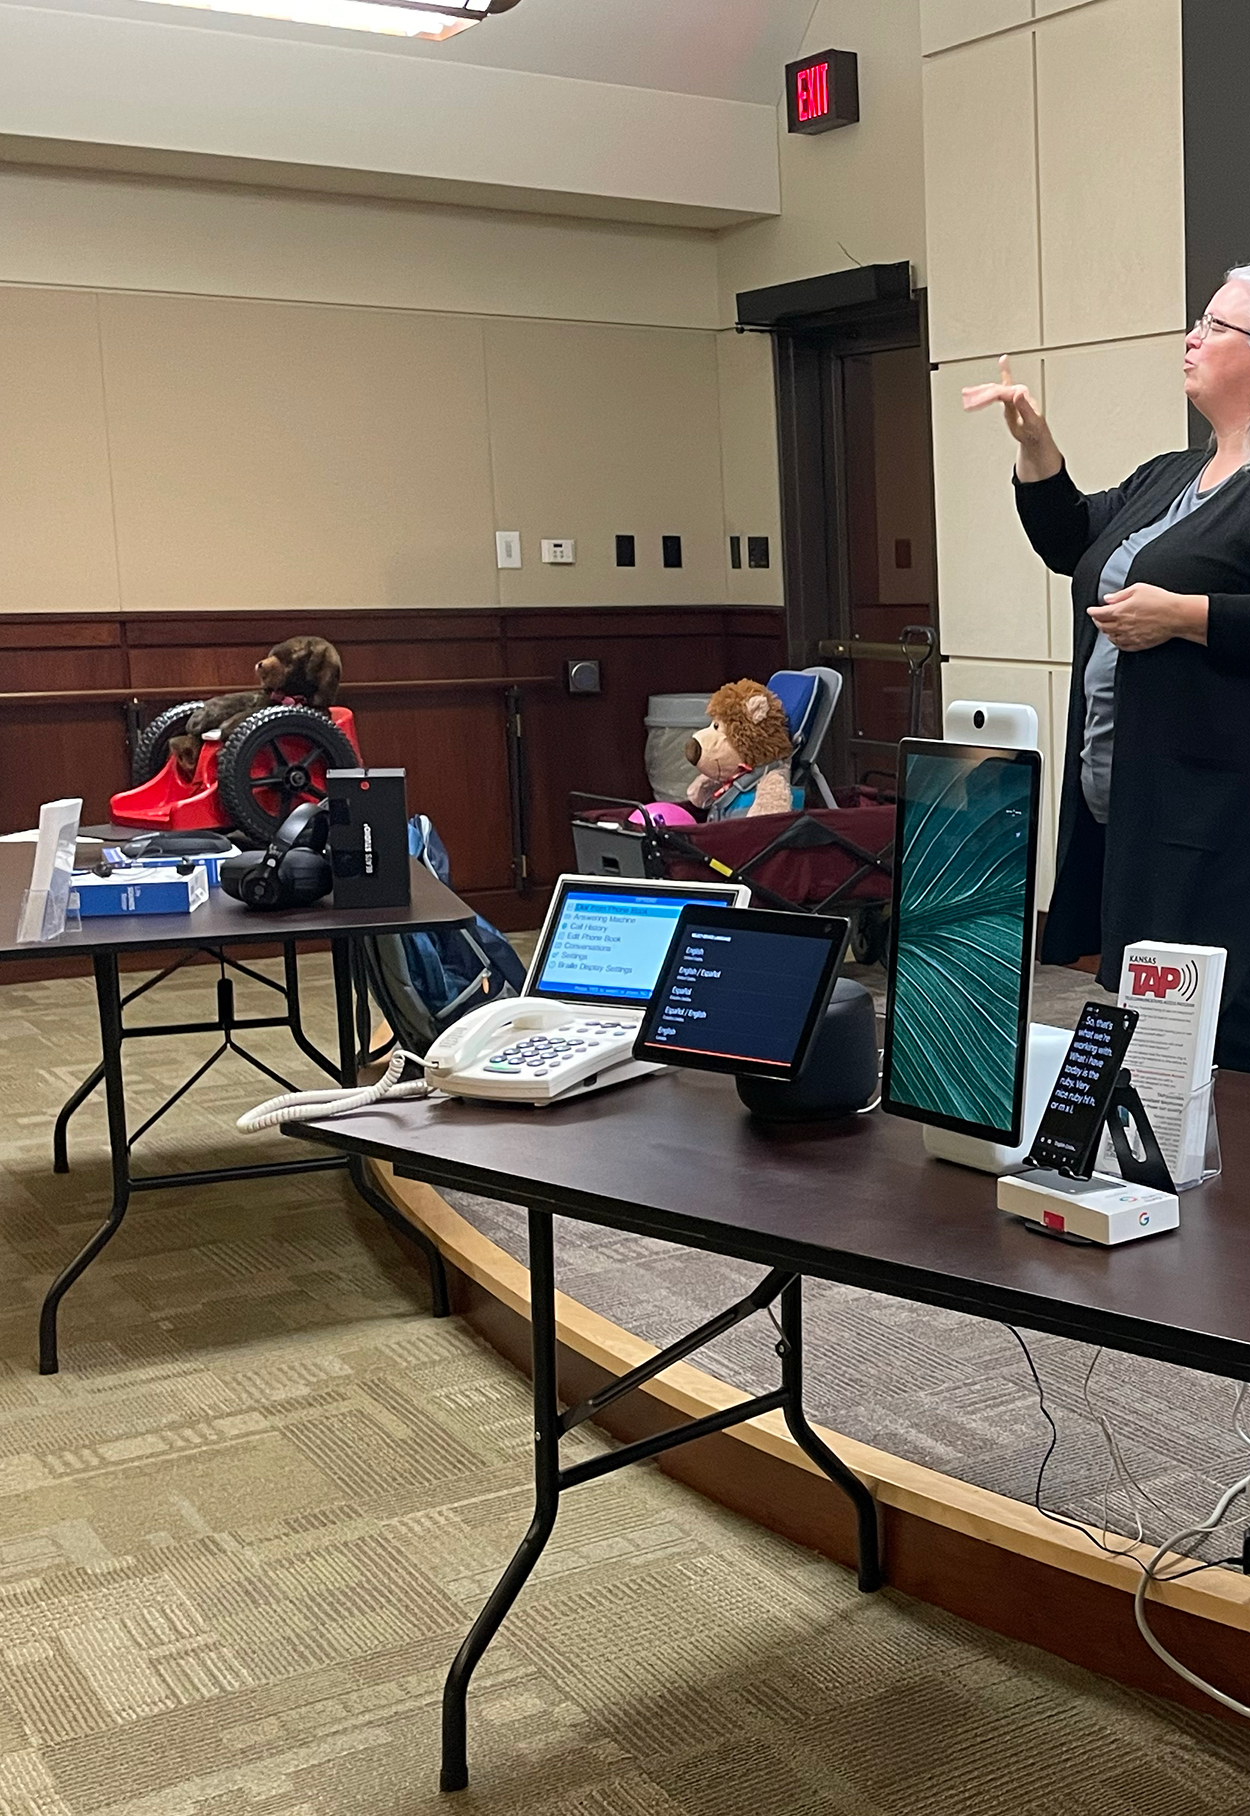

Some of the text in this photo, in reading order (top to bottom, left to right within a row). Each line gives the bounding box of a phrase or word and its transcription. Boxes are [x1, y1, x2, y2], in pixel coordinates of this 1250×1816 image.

[797, 62, 828, 121] EXIT
[608, 906, 630, 914] Phone
[630, 907, 649, 915] Book
[573, 914, 636, 924] Answering Machine
[585, 924, 608, 933] History
[567, 932, 621, 943] Edit Phone Book
[564, 942, 611, 952] Conversations
[686, 946, 704, 956] English
[561, 951, 588, 961] Settings
[1129, 955, 1157, 964] KANSAS
[558, 961, 633, 975] Braille Display Settings
[679, 966, 697, 976] English
[1128, 963, 1181, 998] TAP
[688, 1009, 707, 1019] English
[1096, 1019, 1113, 1030] that's
[657, 1026, 676, 1036] English
[1078, 1029, 1111, 1043] what we're
[1074, 1041, 1098, 1055] working
[1069, 1051, 1086, 1063] What
[1088, 1056, 1104, 1068] have
[1065, 1064, 1100, 1080] today is the
[1076, 1079, 1090, 1092] Very
[1055, 1088, 1069, 1099] nice
[1068, 1093, 1083, 1104] ruby
[1139, 1211, 1149, 1226] G
